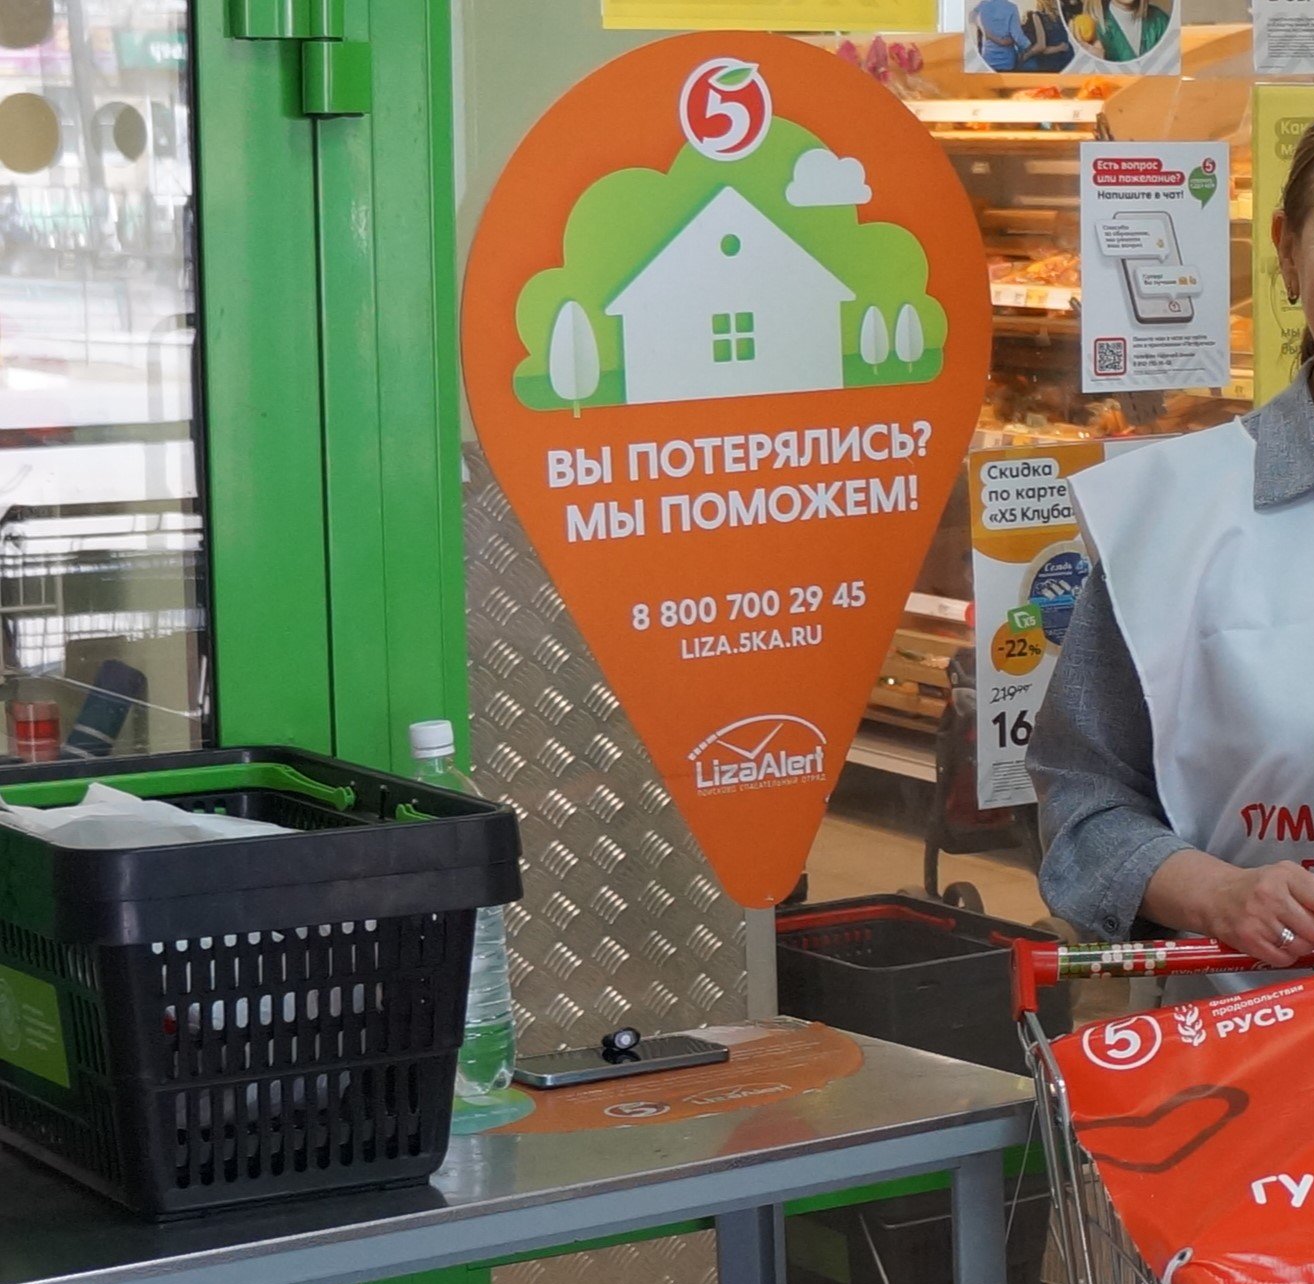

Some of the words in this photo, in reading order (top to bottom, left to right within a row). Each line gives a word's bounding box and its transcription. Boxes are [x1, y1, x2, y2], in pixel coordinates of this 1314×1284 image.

[703, 90, 752, 153] 5
[1097, 160, 1119, 170] Есть
[1122, 162, 1158, 171] вопрос
[1097, 174, 1116, 183] или
[1119, 172, 1181, 183] пожелание?
[1097, 190, 1152, 200] Напишите
[1155, 192, 1161, 200] в
[1163, 190, 1184, 200] чат!
[548, 446, 612, 488] ВЫ
[629, 420, 932, 482] ПОТЕРЯЛИСЬ?
[987, 462, 1053, 480] Скидка
[567, 498, 645, 542] МЫ
[660, 475, 919, 534] ПОМОЖЕМ!
[987, 486, 1010, 503] по
[1015, 484, 1068, 503] карте
[632, 604, 650, 631] 8
[660, 597, 718, 629] 800
[727, 588, 781, 621] 700
[789, 585, 823, 614] 29
[833, 580, 867, 609] 45
[681, 624, 823, 660] LIZA.5KA.RU
[998, 638, 1042, 659] -22%
[696, 745, 824, 789] LizaAlert
[1212, 984, 1304, 1016] продовольствия
[1216, 1004, 1295, 1038] РУСЬ
[1105, 1020, 1142, 1060] 5
